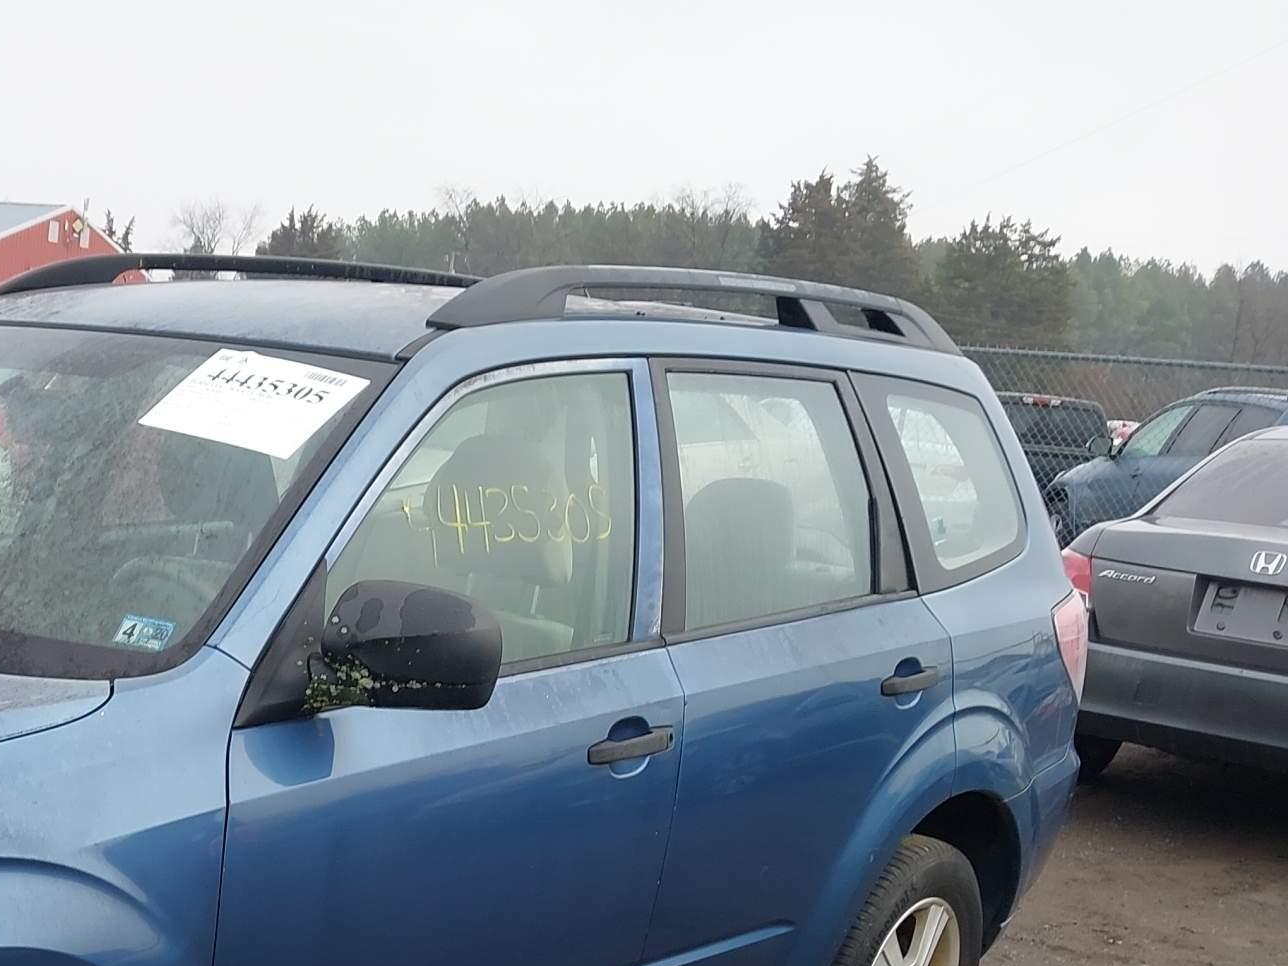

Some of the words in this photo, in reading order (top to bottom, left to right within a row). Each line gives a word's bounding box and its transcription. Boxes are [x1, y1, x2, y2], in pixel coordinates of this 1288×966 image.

[208, 367, 330, 404] 44435305
[1097, 568, 1158, 585] Accord
[122, 622, 138, 644] 4
